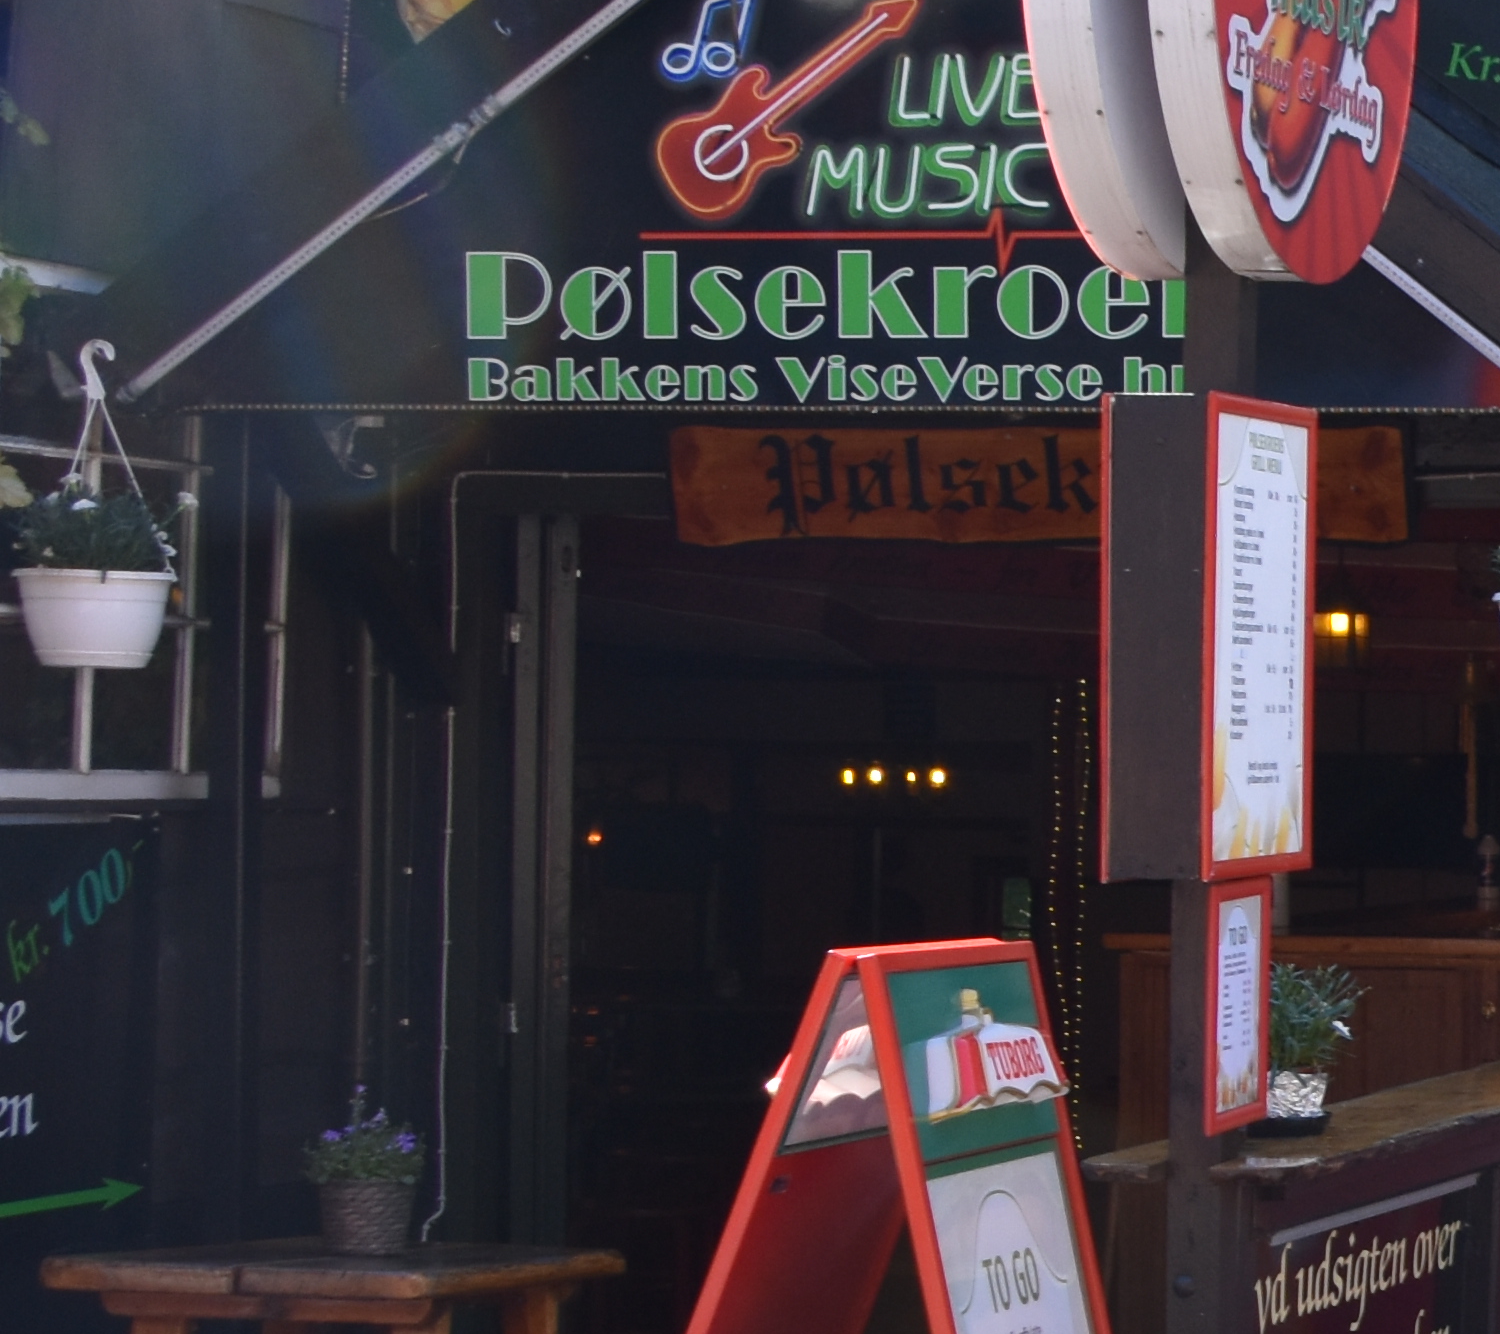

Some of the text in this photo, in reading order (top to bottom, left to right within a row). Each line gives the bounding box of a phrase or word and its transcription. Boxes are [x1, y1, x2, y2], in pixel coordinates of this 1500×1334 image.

[889, 54, 1035, 128] LIVE
[1233, 29, 1293, 113] Fredag
[1320, 65, 1381, 149] Lørdag
[806, 141, 1050, 219] MUSIC
[466, 356, 760, 403] Bakkens
[777, 355, 1103, 402] ViseVerse
[759, 433, 1099, 536] Pølsek
[7, 918, 50, 983] kr.
[985, 1036, 1046, 1082] TUBORG
[982, 1247, 1041, 1314] TO GO
[1294, 1227, 1407, 1331] udsigten
[1413, 1219, 1464, 1278] over
